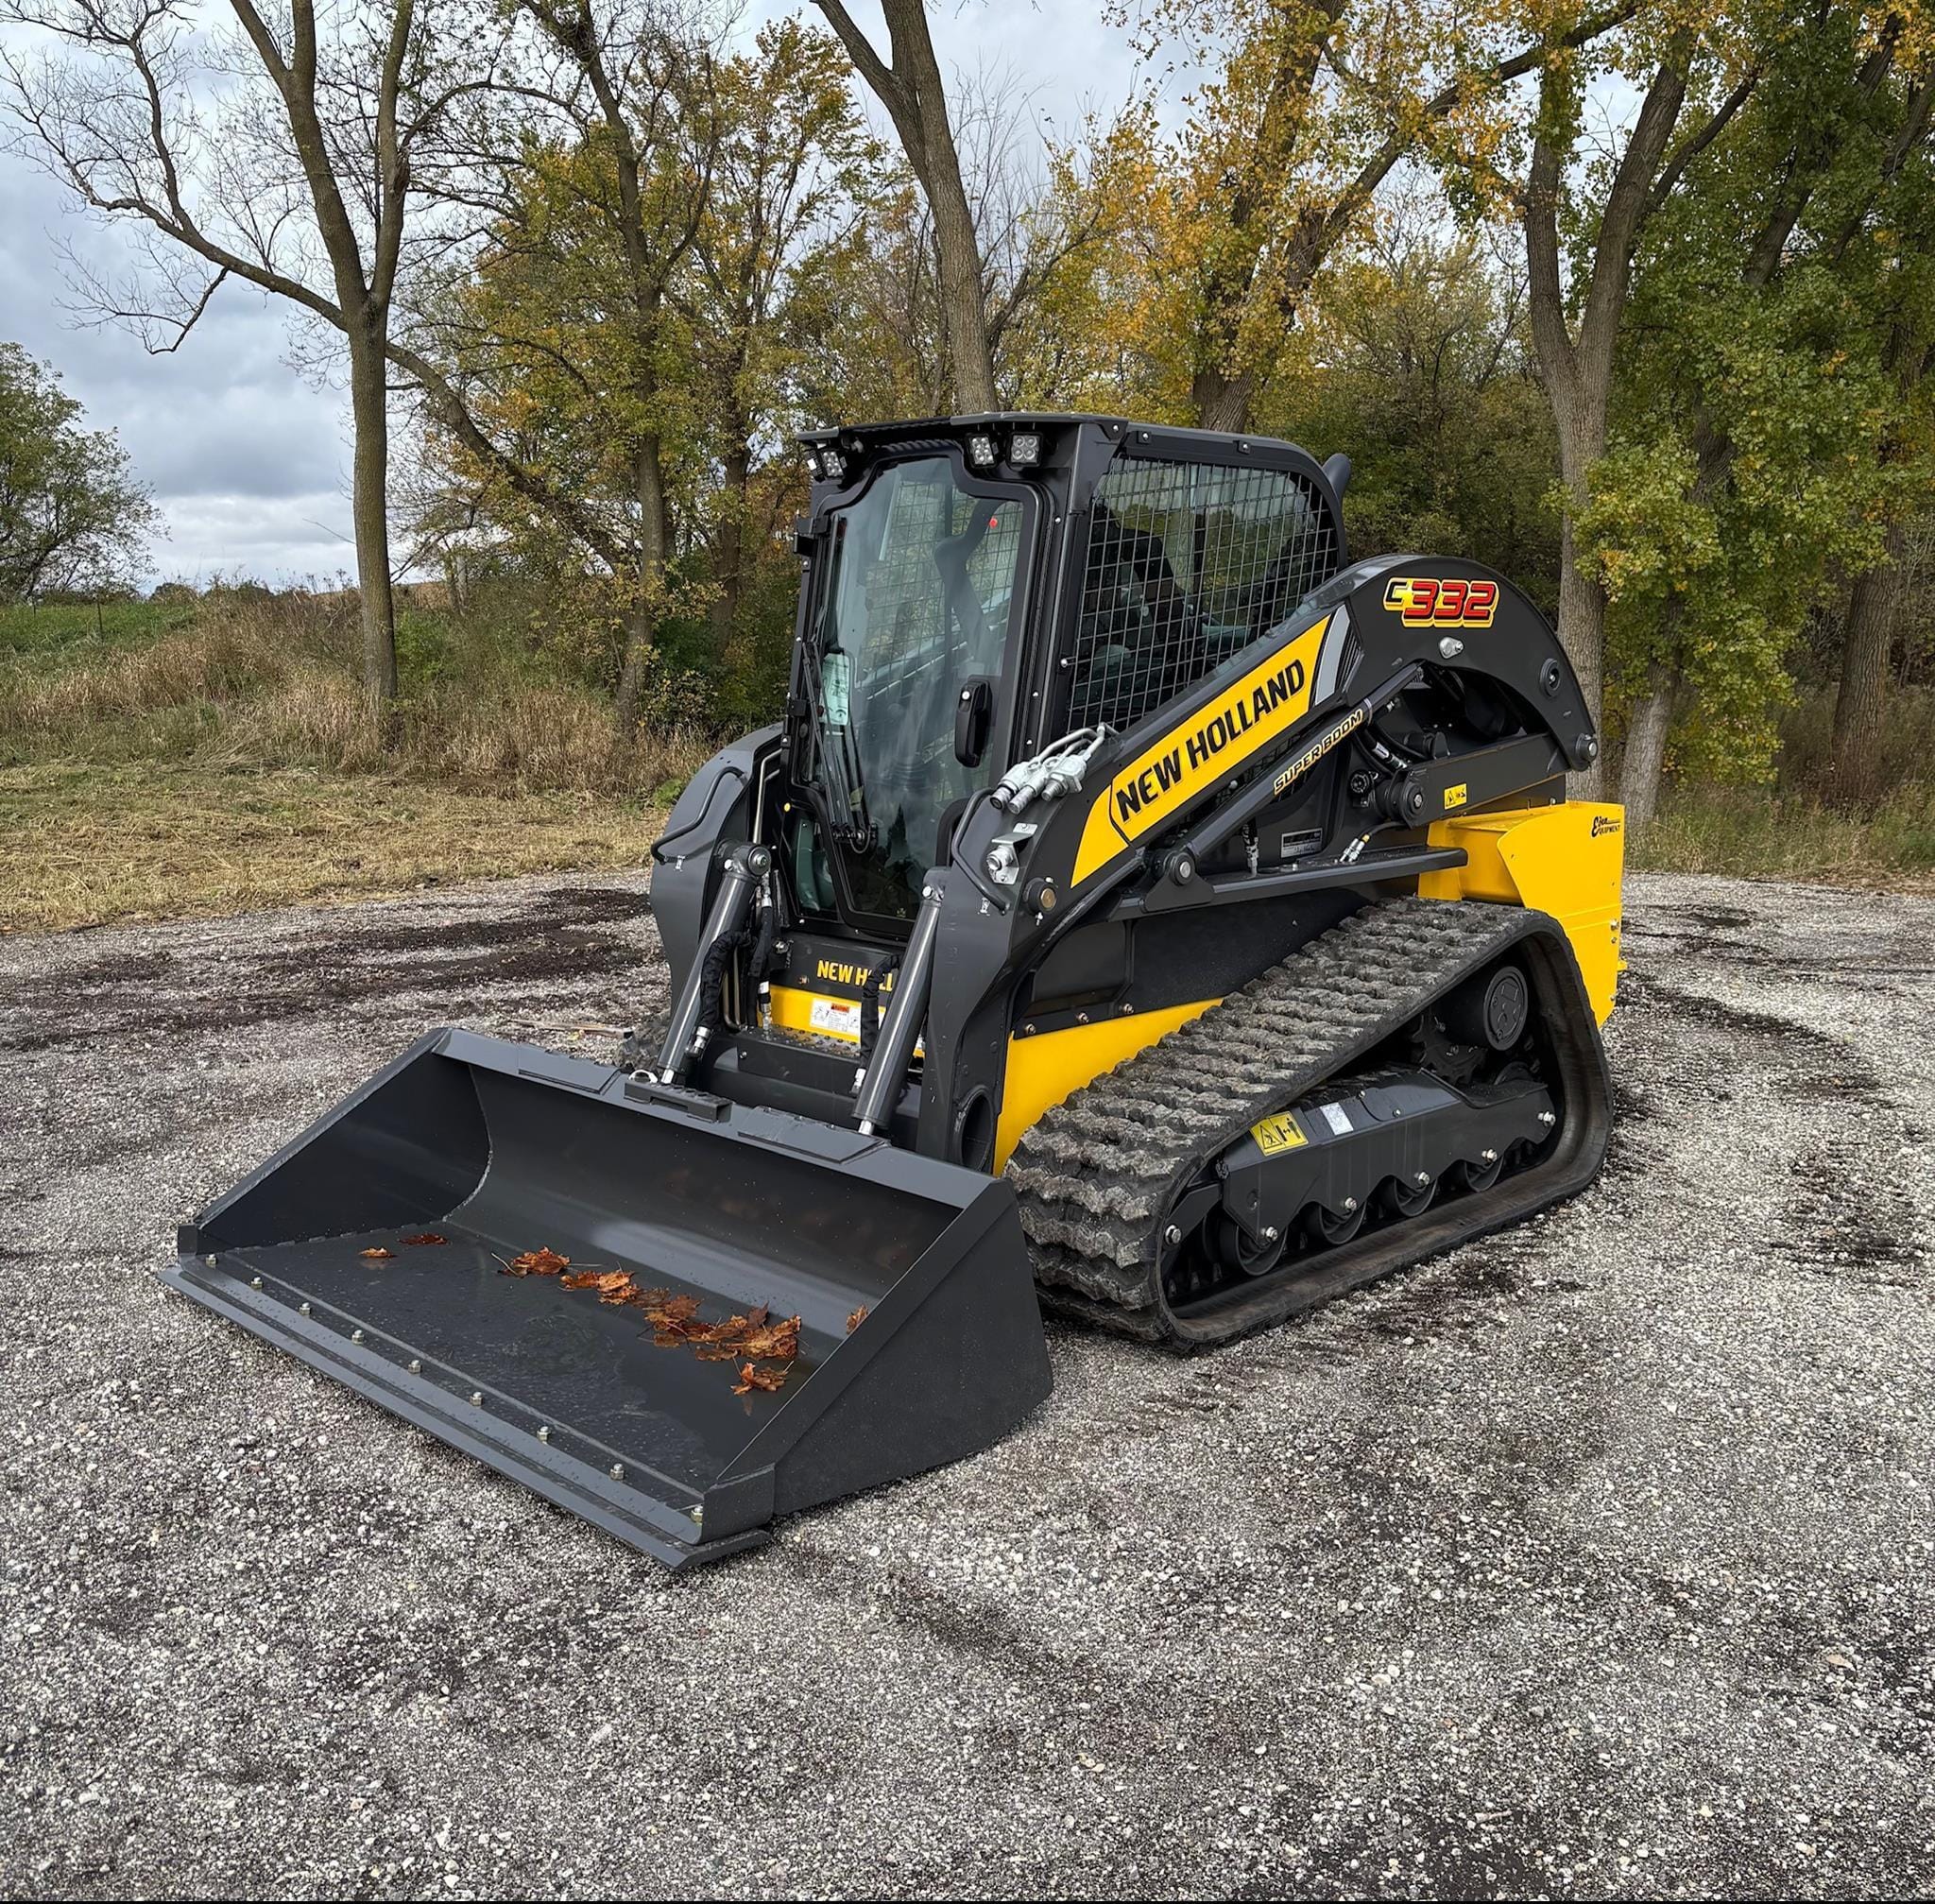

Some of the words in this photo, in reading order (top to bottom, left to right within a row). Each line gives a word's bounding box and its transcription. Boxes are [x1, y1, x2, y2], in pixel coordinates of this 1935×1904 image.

[1116, 746, 1182, 823] NEW
[1186, 659, 1306, 770] HOLLAND
[1274, 744, 1323, 796] SUPER
[1322, 709, 1363, 754] BOOM
[816, 959, 853, 985] NEW
